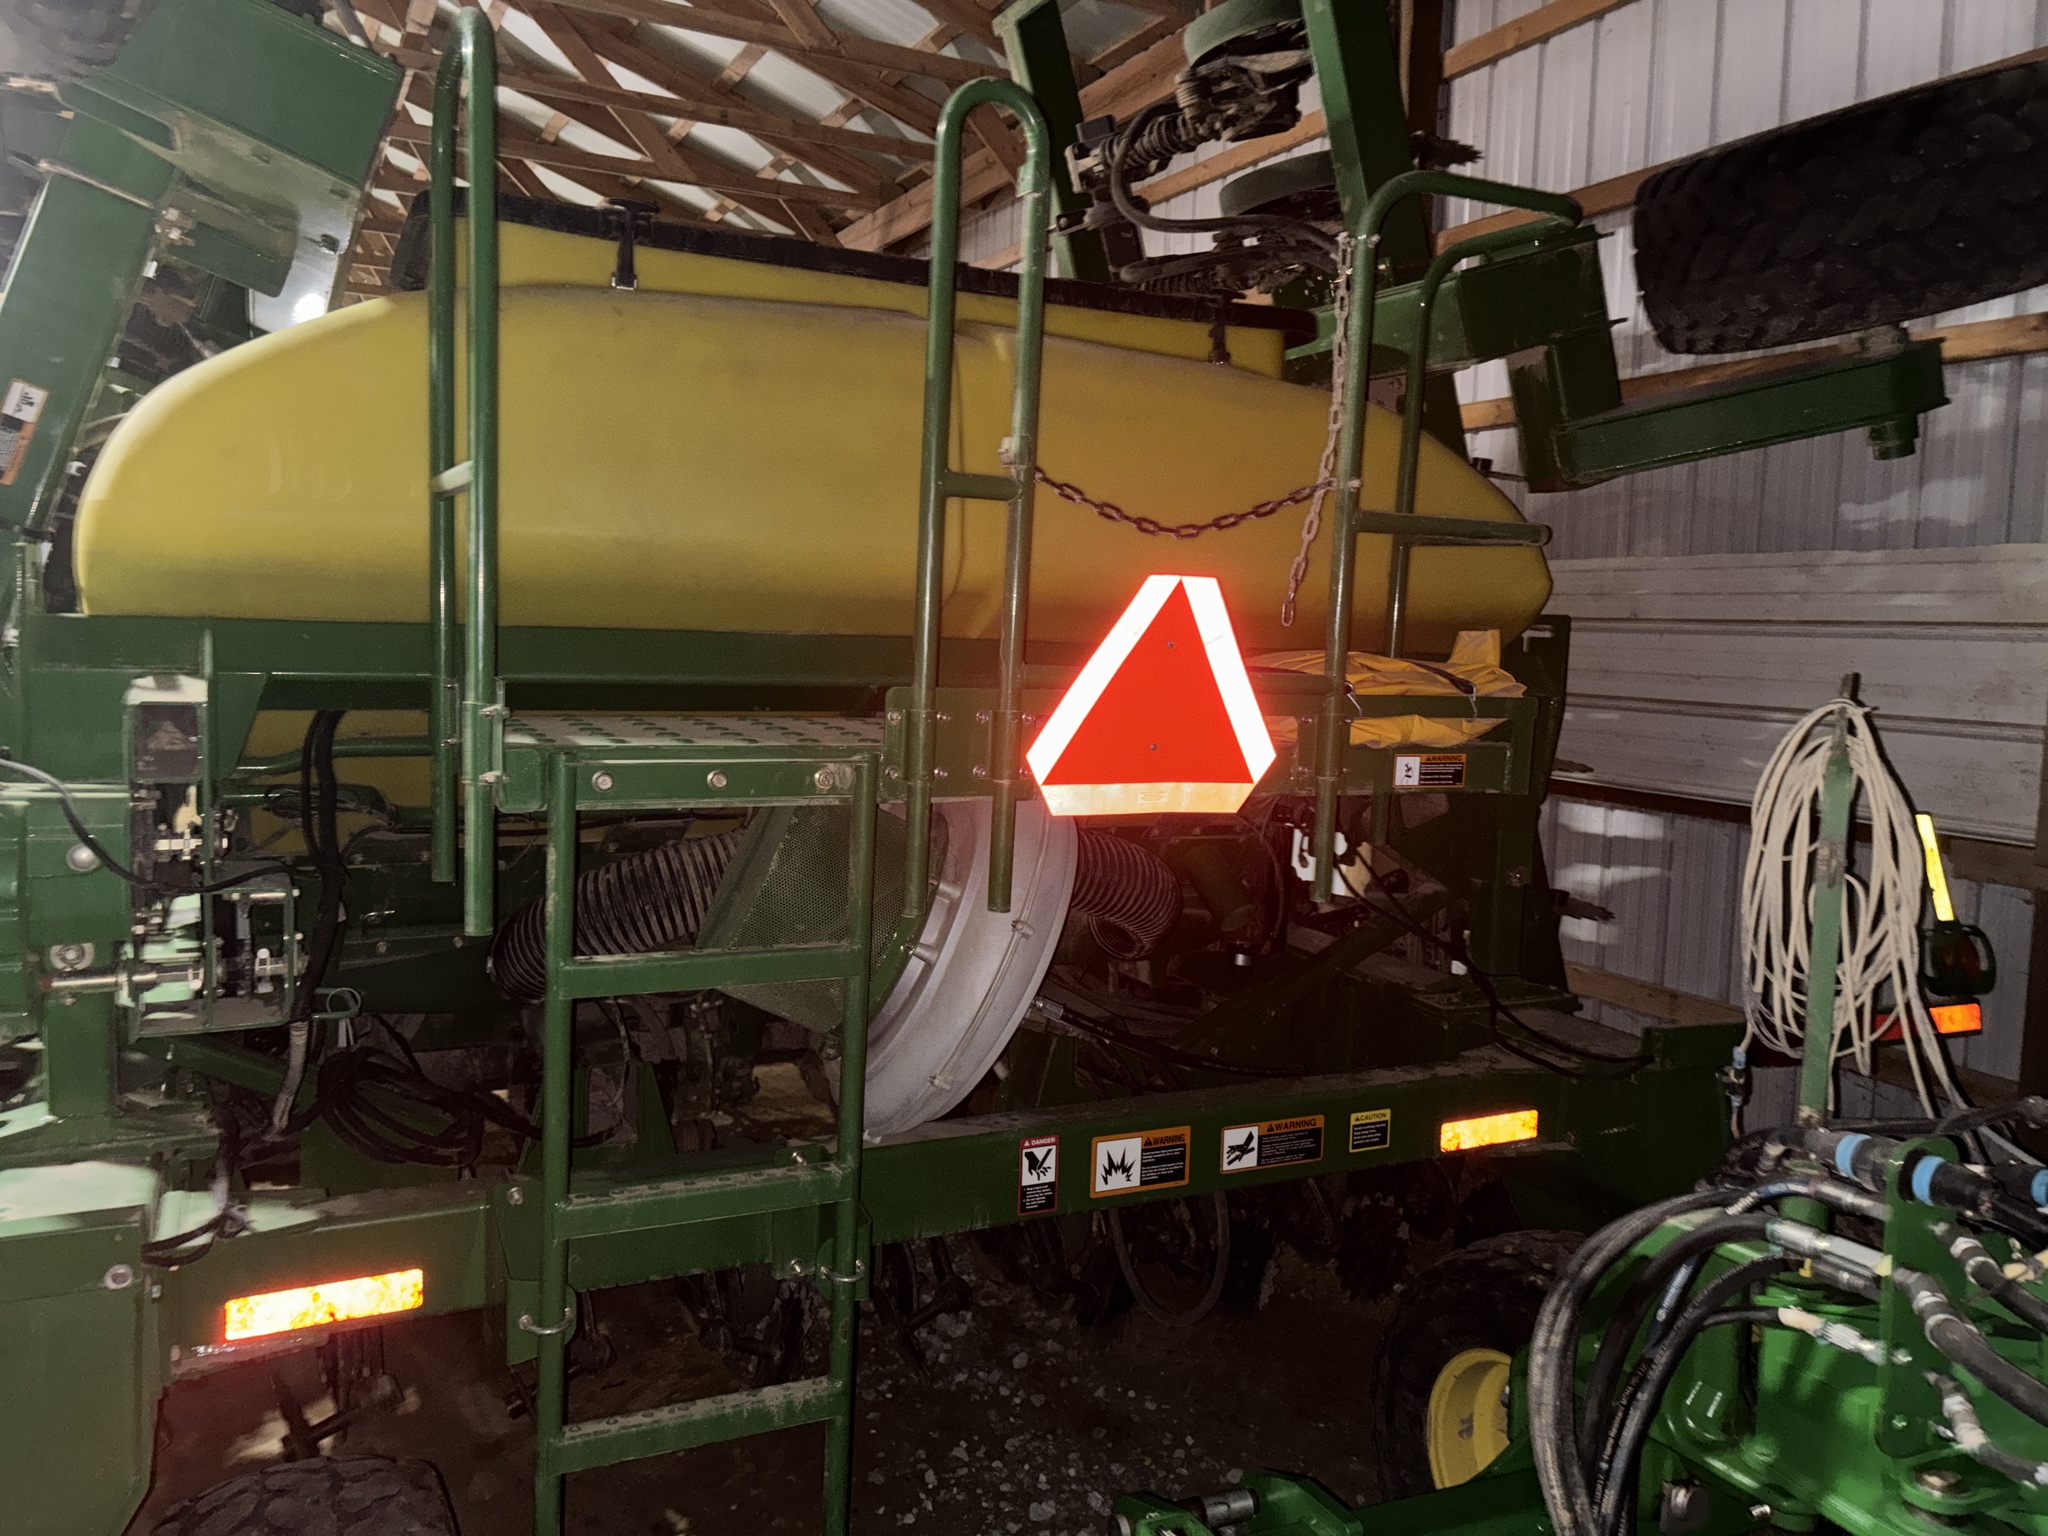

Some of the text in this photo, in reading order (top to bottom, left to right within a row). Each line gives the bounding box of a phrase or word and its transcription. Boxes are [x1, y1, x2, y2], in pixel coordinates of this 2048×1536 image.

[1360, 1112, 1387, 1121] CAUTION
[1273, 1118, 1317, 1131] WARNING
[1031, 1137, 1056, 1146] DANGER
[1152, 1133, 1186, 1146] WARNING
